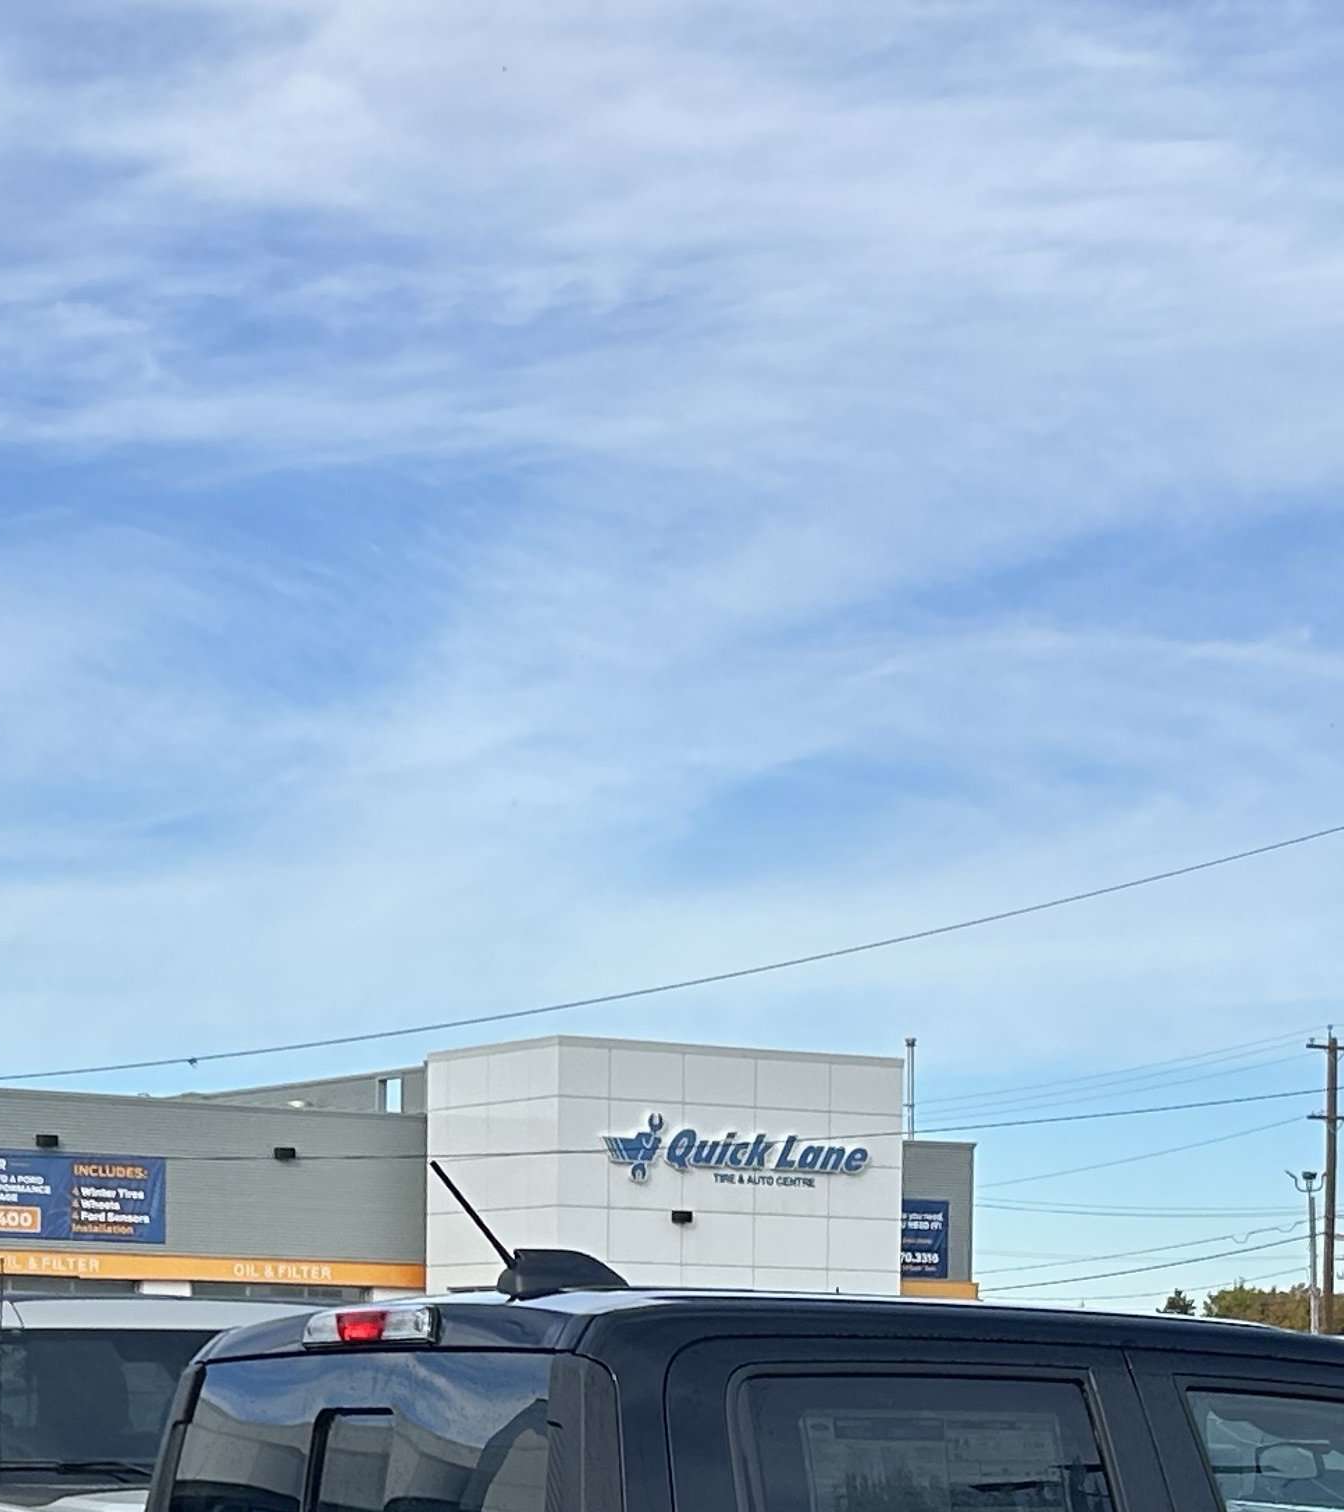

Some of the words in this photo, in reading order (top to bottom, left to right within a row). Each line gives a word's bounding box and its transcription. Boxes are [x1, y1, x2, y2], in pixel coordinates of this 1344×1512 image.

[666, 1128, 774, 1170] Quick
[775, 1135, 869, 1173] Lane
[73, 1164, 149, 1179] INCLUDES:
[713, 1173, 736, 1184] TIRE
[737, 1174, 744, 1184] &
[747, 1174, 774, 1186] AUTO
[775, 1176, 816, 1188] CENTRE
[80, 1186, 116, 1199] Winter
[28, 1257, 39, 1271] &
[40, 1257, 100, 1273] FILTER
[233, 1264, 258, 1277] OIL
[263, 1264, 274, 1278] &
[277, 1264, 333, 1280] FILTER
